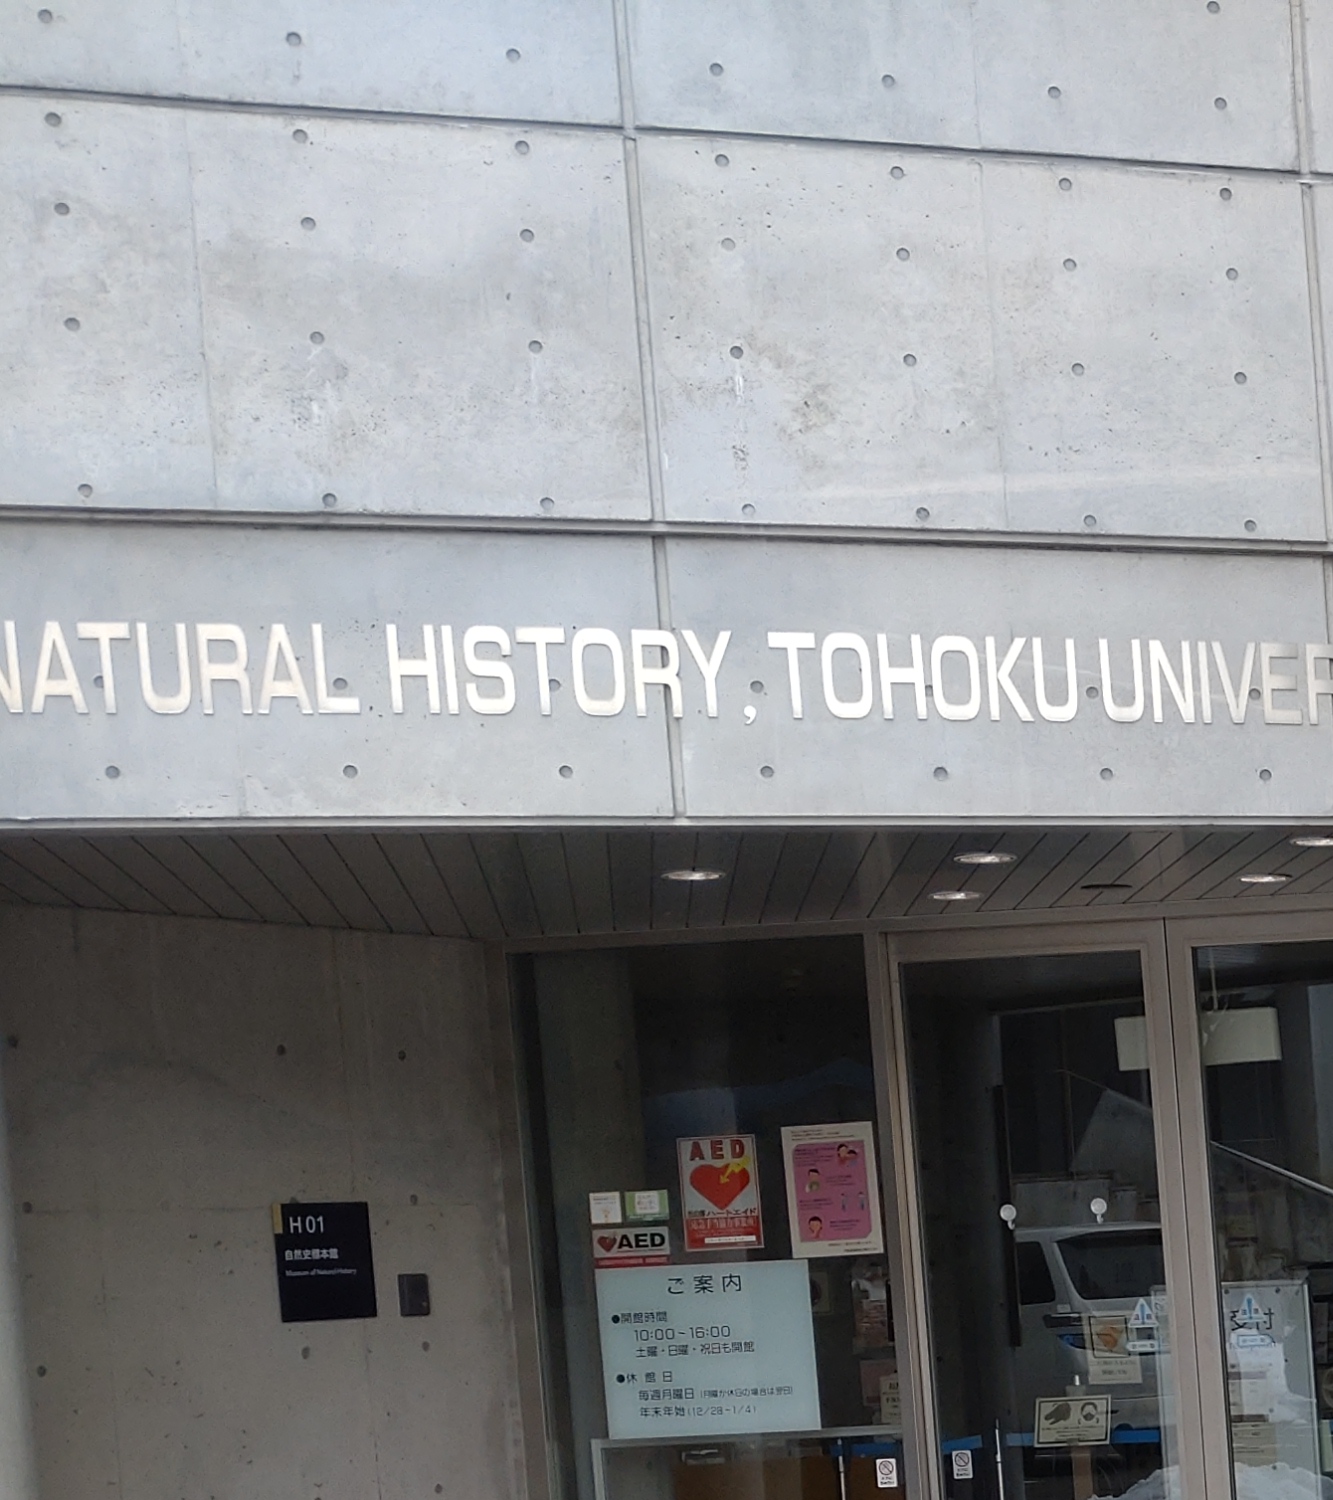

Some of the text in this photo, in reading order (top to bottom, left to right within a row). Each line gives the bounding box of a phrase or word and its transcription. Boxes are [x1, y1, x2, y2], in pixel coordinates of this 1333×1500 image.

[768, 631, 1080, 723] TOHOKU
[689, 1138, 746, 1162] AED
[617, 1232, 666, 1250] AED
[667, 1273, 742, 1295] ご案内
